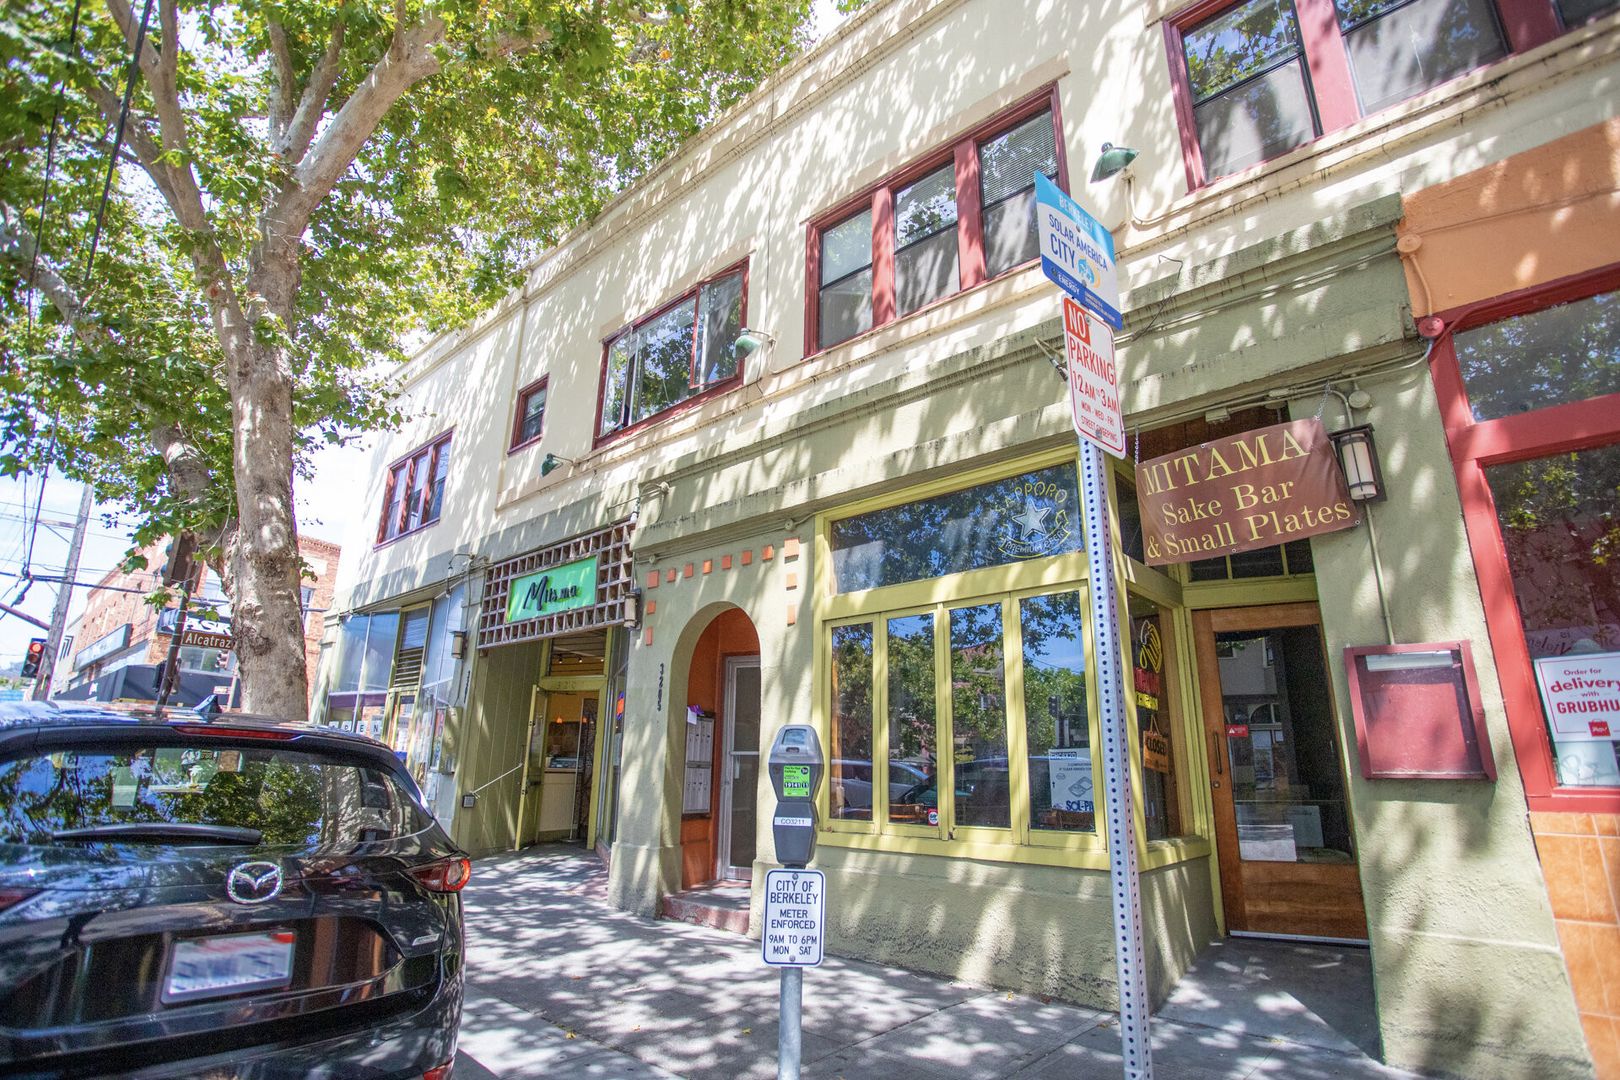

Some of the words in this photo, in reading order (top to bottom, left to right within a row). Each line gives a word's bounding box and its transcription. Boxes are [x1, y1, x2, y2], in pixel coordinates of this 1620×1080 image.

[1049, 214, 1075, 246] SOLAR
[1076, 236, 1108, 271] AMERICA
[1050, 233, 1075, 269] CITY
[1068, 303, 1087, 335] NO
[1070, 335, 1115, 385] PARKING
[1073, 370, 1096, 400] 12AM
[1101, 388, 1118, 414] 3AM
[1081, 415, 1096, 430] STREET
[1094, 409, 1105, 421] WED
[1143, 429, 1310, 496] MITAMA
[1162, 497, 1223, 526] Sake
[1230, 480, 1294, 511] Bar
[1147, 535, 1162, 559] &
[1164, 522, 1237, 556] Small
[1244, 501, 1351, 542] Plates
[185, 633, 231, 649] Alcatraz
[1563, 668, 1588, 676] Order
[1589, 667, 1602, 675] for
[1581, 690, 1600, 698] with
[776, 880, 798, 892] CITY
[802, 881, 814, 892] OF
[770, 892, 819, 905] BERKELEY
[780, 909, 808, 919] METER
[771, 920, 816, 930] ENFORCED
[769, 934, 785, 944] 9AM
[788, 935, 798, 944] TO
[801, 936, 818, 945] 6PM
[773, 946, 790, 955] MON
[799, 946, 812, 956] SAT
